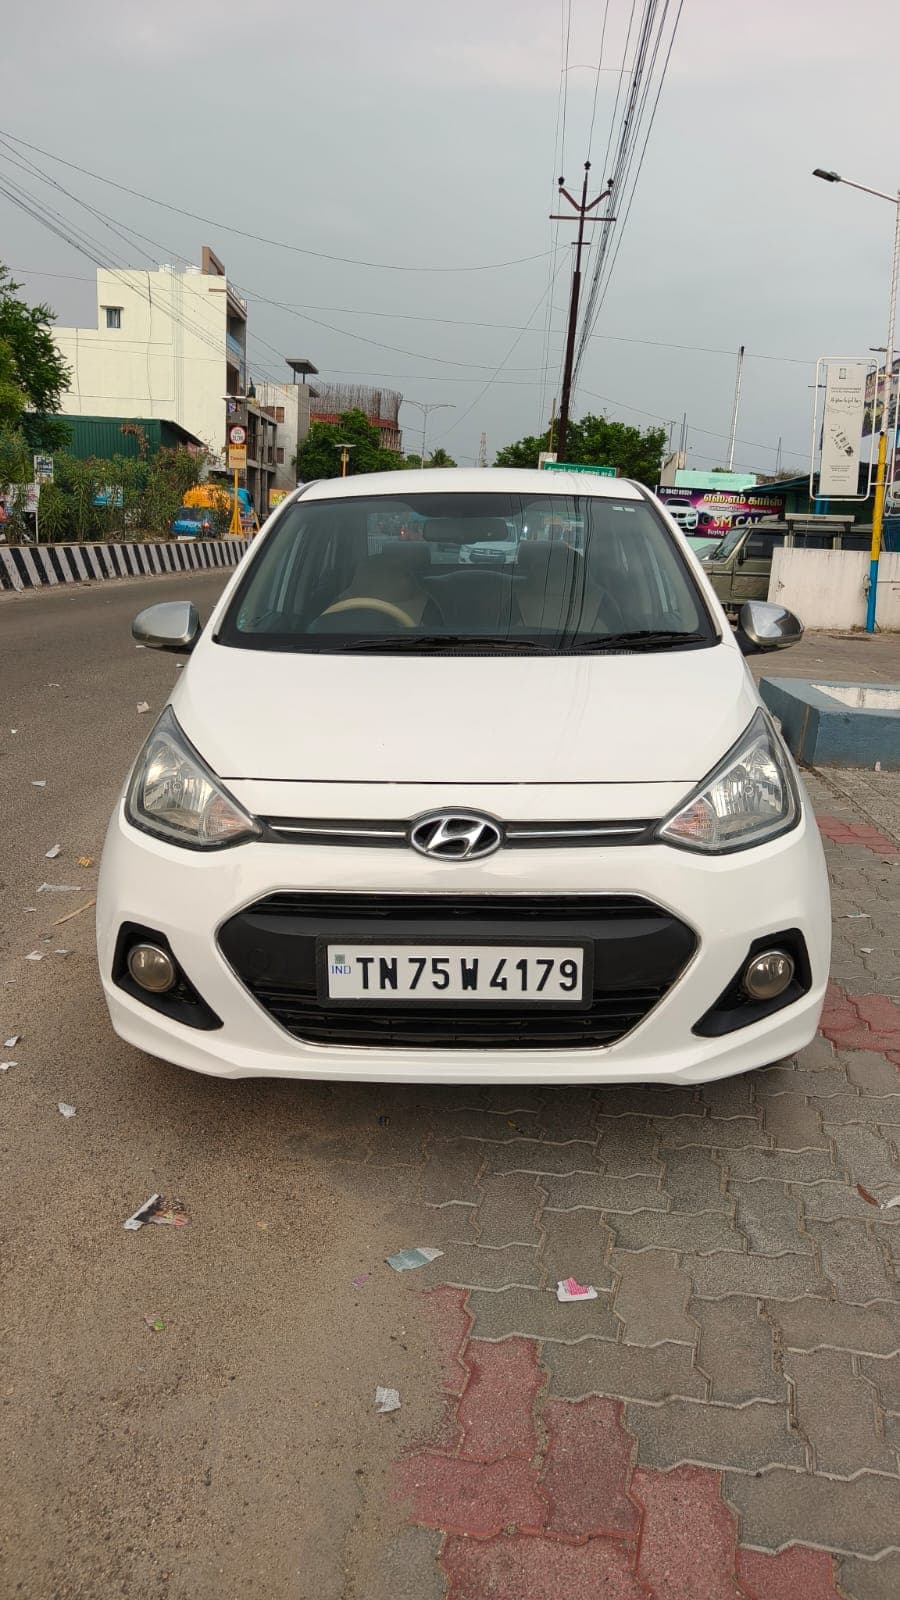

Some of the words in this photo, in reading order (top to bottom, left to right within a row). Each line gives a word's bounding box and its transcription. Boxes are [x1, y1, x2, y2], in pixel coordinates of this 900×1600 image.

[713, 515, 732, 528] SM
[331, 965, 351, 975] IND
[356, 957, 398, 990] TN
[408, 957, 450, 990] 75
[461, 958, 479, 990] W
[490, 958, 578, 992] 4179
